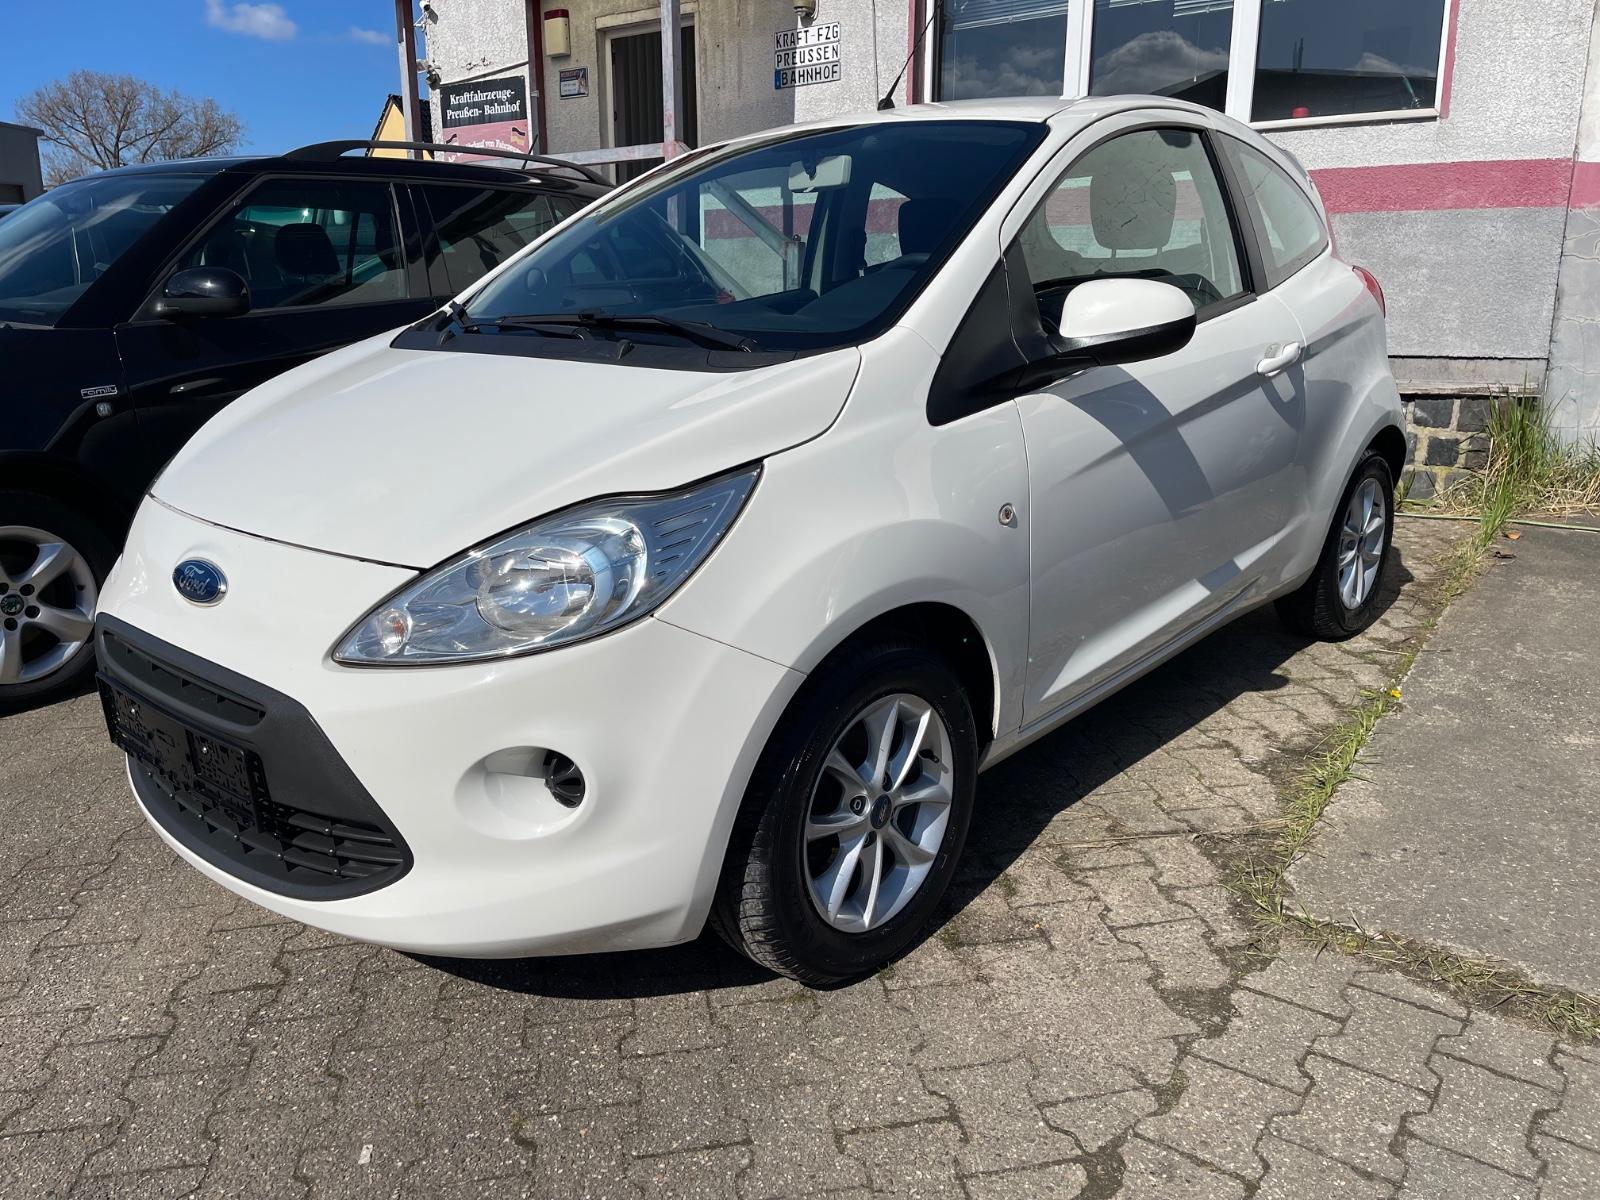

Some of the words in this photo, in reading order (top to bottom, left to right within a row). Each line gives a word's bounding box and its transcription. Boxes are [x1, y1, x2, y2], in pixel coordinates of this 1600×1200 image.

[776, 45, 839, 68] PREUSSEN
[781, 64, 839, 86] BAHNHOF
[450, 88, 515, 105] Kraftfahrzeuge-
[446, 107, 482, 120] Preußen-
[484, 100, 521, 116] Bahnhof
[178, 564, 211, 596] Ford
